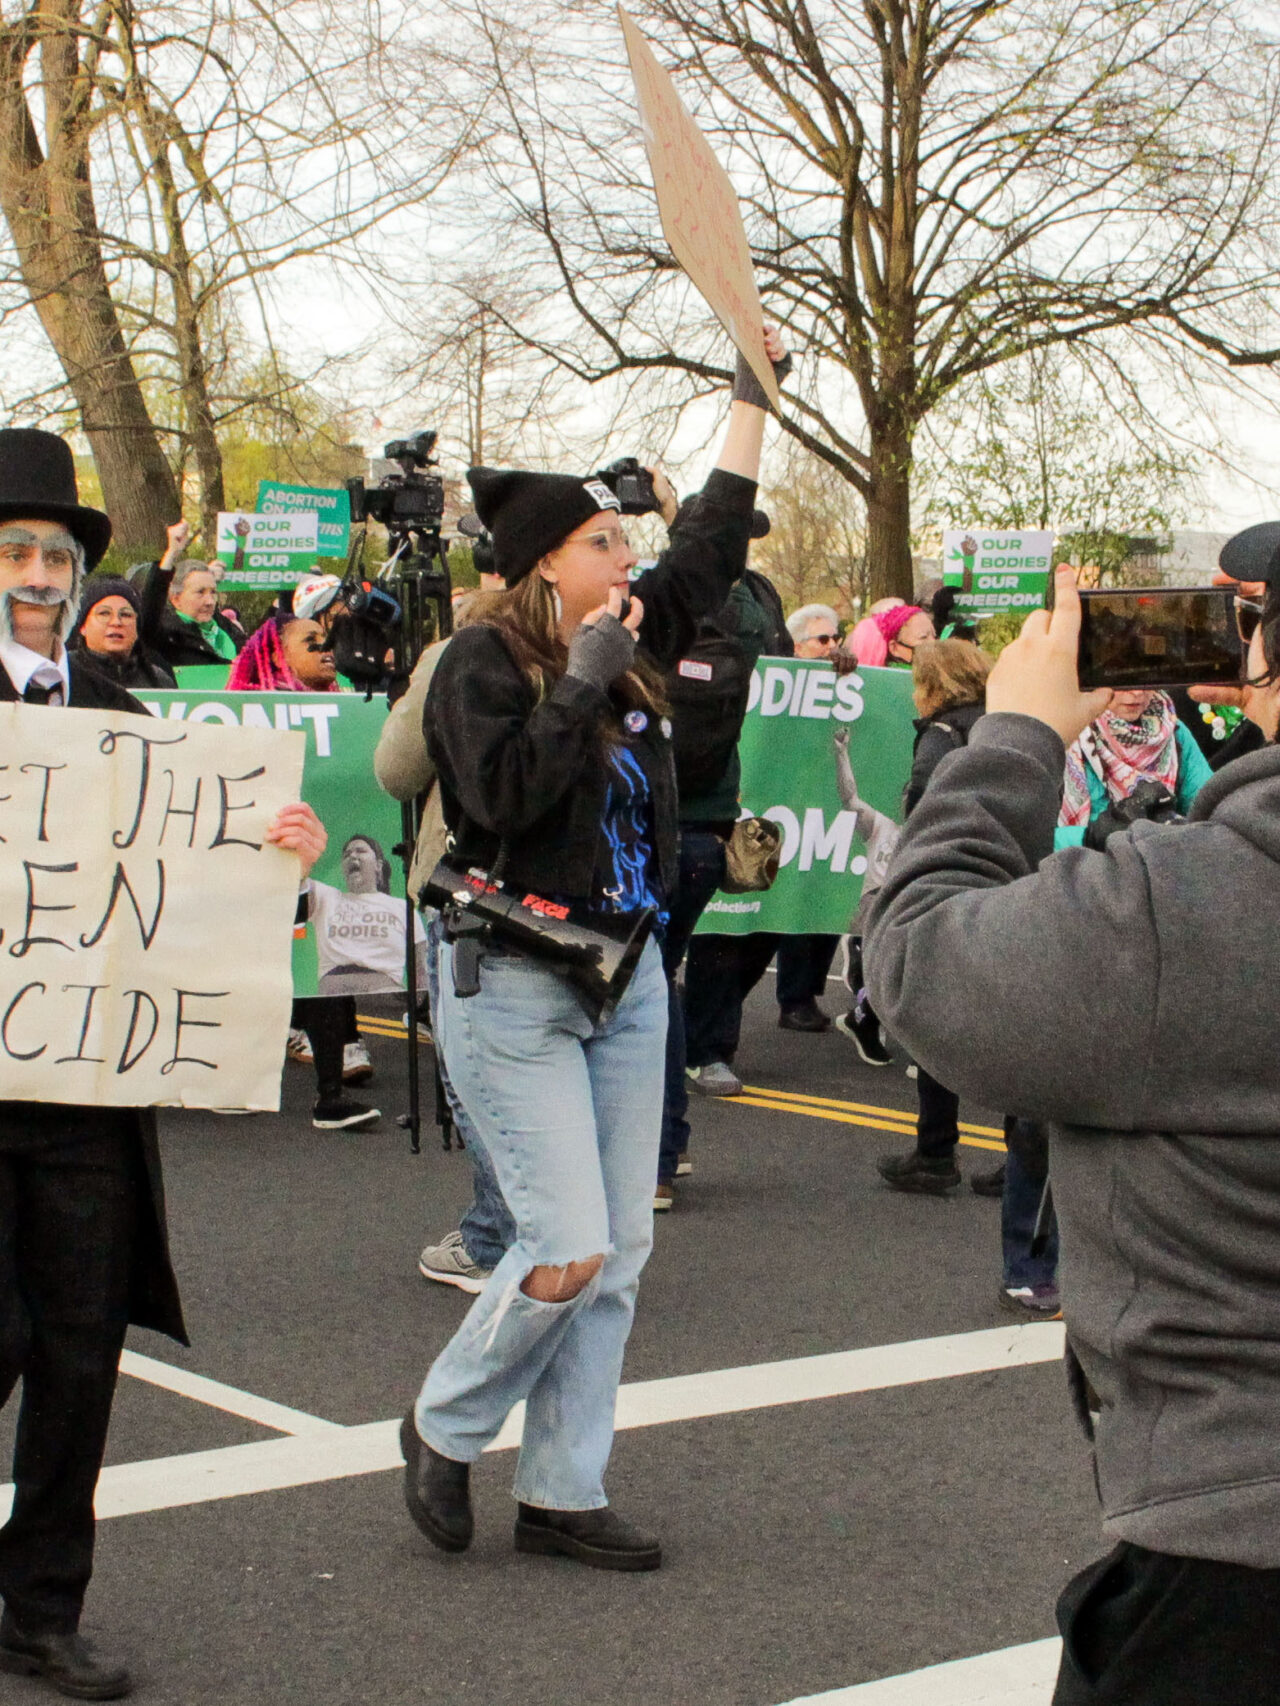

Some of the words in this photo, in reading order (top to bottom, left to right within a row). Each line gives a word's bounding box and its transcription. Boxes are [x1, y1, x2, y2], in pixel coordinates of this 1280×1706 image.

[264, 488, 337, 509] ABORTION
[254, 521, 291, 532] OUR
[252, 537, 316, 549] BODIES
[982, 538, 1023, 550] OUR
[248, 554, 290, 567] OUR
[980, 556, 1048, 568] BODIES
[977, 575, 1019, 589] OUR
[98, 728, 267, 852] THE
[736, 805, 868, 876] OM.
[362, 912, 397, 926] OUR
[328, 924, 389, 939] BODIES
